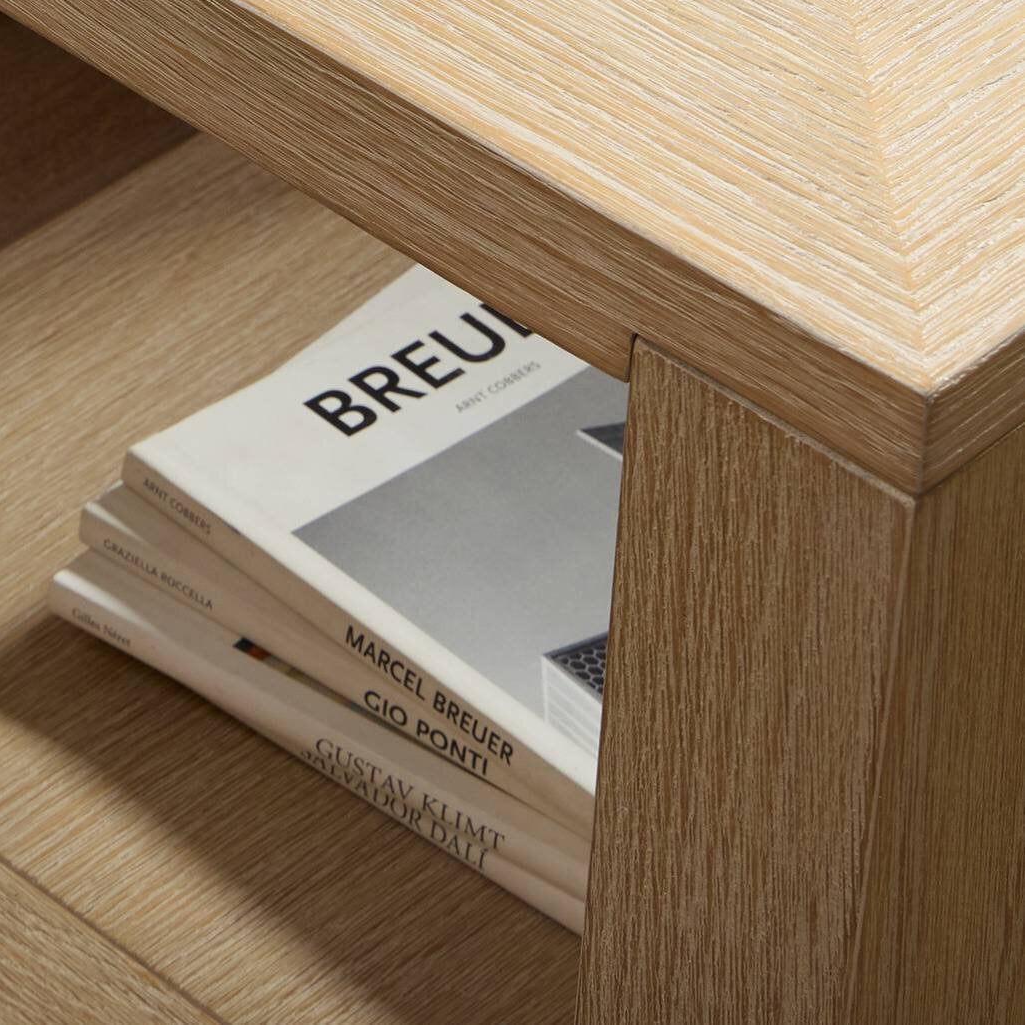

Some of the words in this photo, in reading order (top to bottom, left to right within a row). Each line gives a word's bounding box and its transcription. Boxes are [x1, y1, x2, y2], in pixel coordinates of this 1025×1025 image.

[455, 388, 487, 413] ARNT
[487, 359, 542, 395] COBBERS
[160, 571, 214, 612] ROCCELLA
[345, 625, 426, 702] MARCEL
[432, 690, 515, 766] BREUER
[363, 690, 408, 727] GIO
[416, 718, 489, 776] PONTI
[315, 738, 414, 801] GUSTAV
[422, 793, 506, 850] KLIMT
